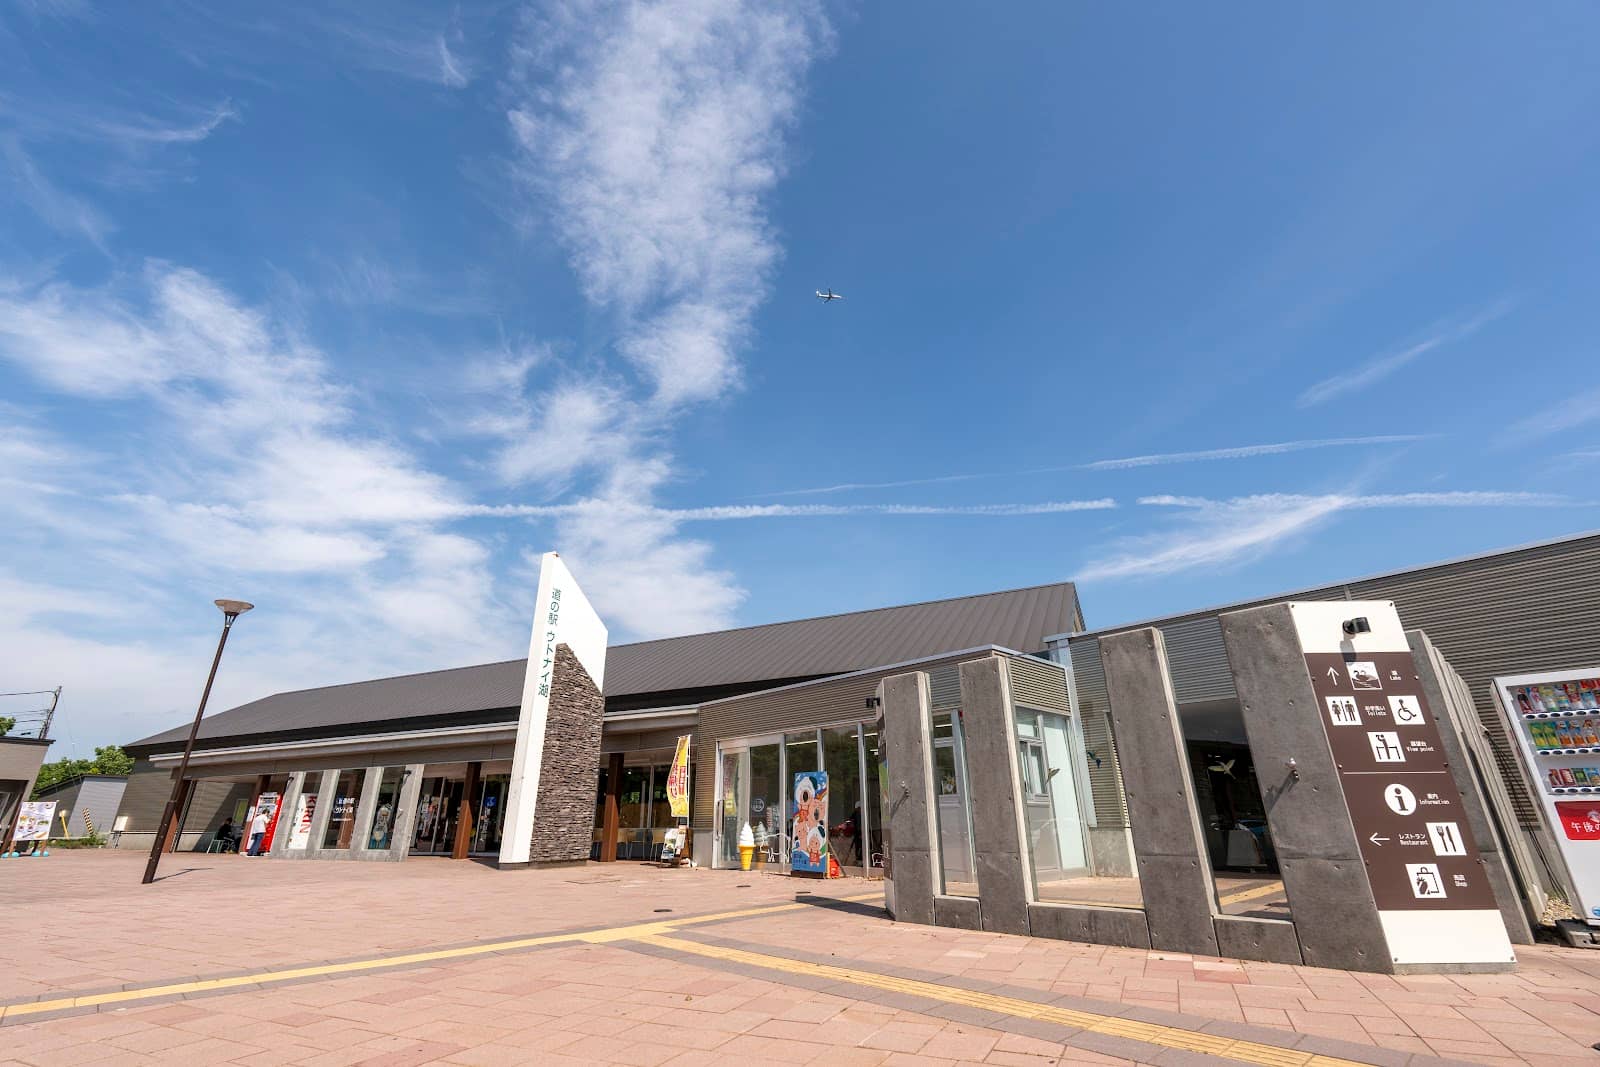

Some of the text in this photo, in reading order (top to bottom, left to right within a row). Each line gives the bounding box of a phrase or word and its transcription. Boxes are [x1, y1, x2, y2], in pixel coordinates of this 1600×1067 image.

[538, 587, 562, 698] 道の駅 ウトナイ湖
